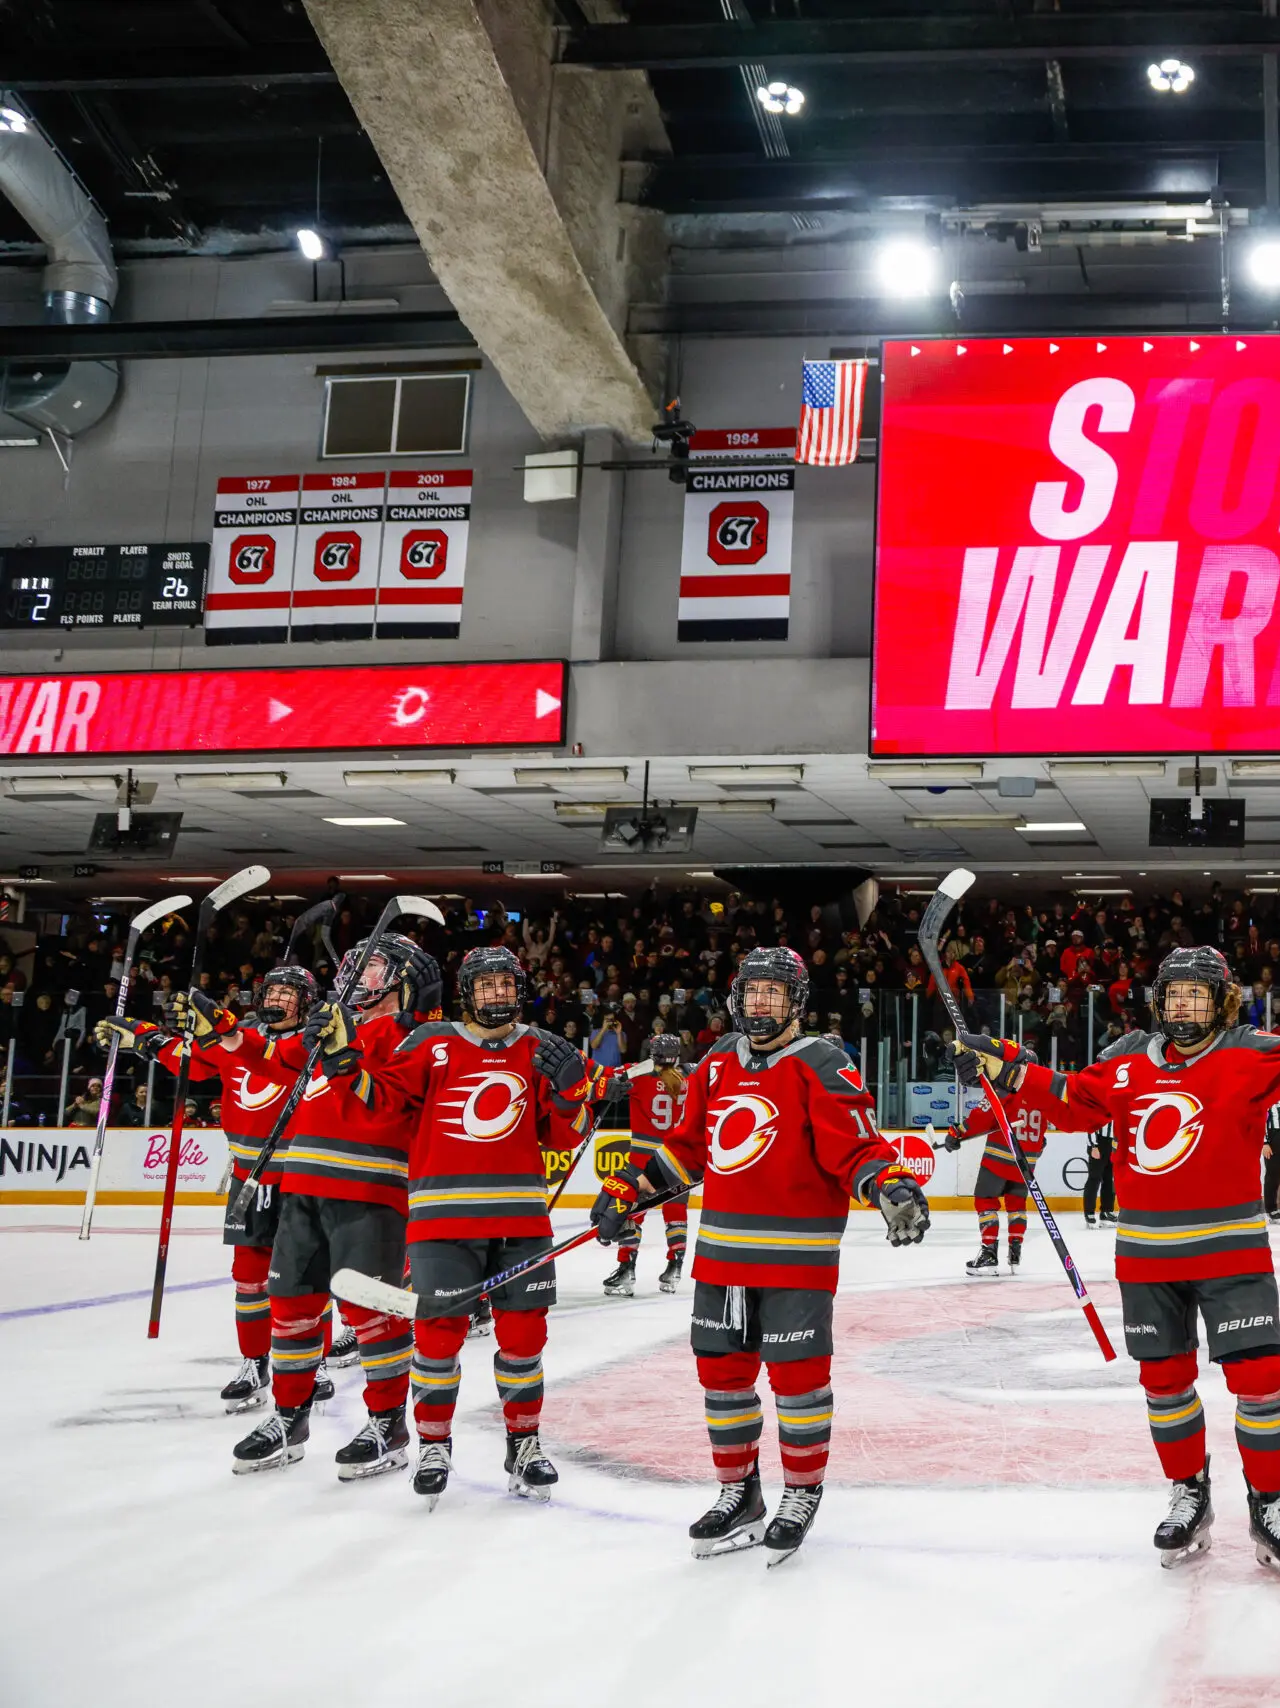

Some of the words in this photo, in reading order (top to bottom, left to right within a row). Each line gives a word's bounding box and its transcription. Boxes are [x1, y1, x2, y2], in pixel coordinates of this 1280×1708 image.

[726, 433, 759, 445] 1984
[246, 480, 271, 491] 1977
[332, 476, 356, 487] 1984
[417, 474, 444, 485] 2001
[693, 473, 789, 489] CHAMPIONS
[246, 497, 267, 507] OHL
[332, 494, 352, 503] OHL
[419, 491, 441, 501] OHL
[219, 511, 292, 525] CHAMPIONS
[304, 508, 378, 521] CHAMPIONS
[391, 507, 465, 519] CHAMPIONS
[73, 547, 105, 556] PENALTY
[120, 546, 148, 555] PLAYER
[167, 553, 191, 561] SHOTS
[162, 561, 174, 569] ON
[175, 560, 194, 569] GOAL
[163, 577, 189, 598] 26
[32, 594, 51, 621] 2
[153, 601, 172, 610] TEAM
[173, 601, 197, 610] FOULS
[61, 616, 74, 625] FLS
[76, 614, 103, 624] POINTS
[113, 614, 141, 623] PLAYER
[116, 976, 130, 1018] BAUE
[1016, 1108, 1041, 1143] 29
[143, 1134, 208, 1169] Babie
[0, 1137, 91, 1183] NINJA
[178, 1173, 206, 1182] anything
[1031, 1190, 1060, 1240] BAUER
[483, 1261, 528, 1290] FLYLITE
[526, 1280, 557, 1292] BAU
[1217, 1315, 1273, 1334] BAUER
[762, 1329, 815, 1342] BAUER
